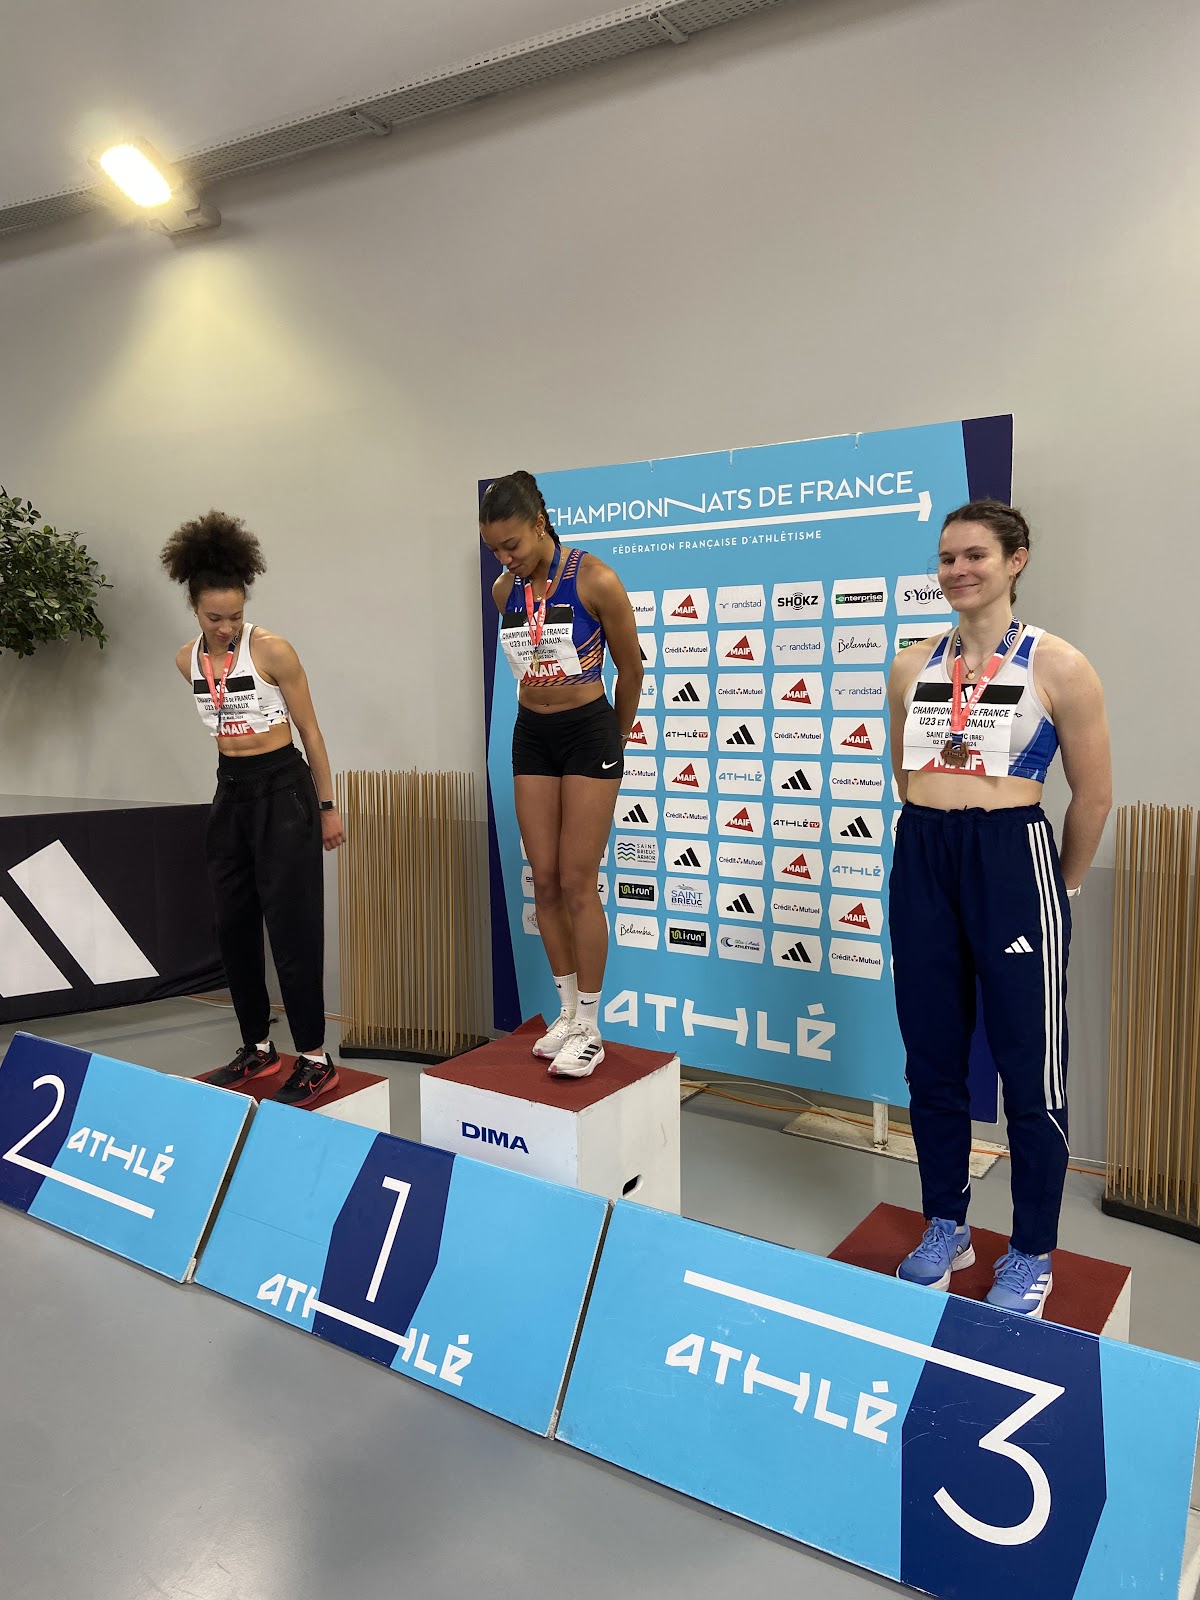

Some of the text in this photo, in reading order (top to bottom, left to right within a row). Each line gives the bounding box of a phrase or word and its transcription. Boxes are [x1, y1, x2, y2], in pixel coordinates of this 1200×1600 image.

[545, 470, 913, 527] CHAMPIONNATS DE FRANCE
[612, 530, 822, 555] FÉDÉRATION FRANÇAISE D'ATHLÉTISME
[777, 594, 819, 608] SHOKZ
[836, 592, 883, 604] enterprise
[732, 600, 762, 609] randstad
[675, 606, 696, 615] MAIF
[547, 628, 569, 636] FRANCE
[528, 637, 562, 646] NONAUX
[789, 642, 821, 651] randstad
[838, 636, 882, 653] Belambra
[730, 648, 752, 656] MAIF
[786, 690, 808, 699] MAIF
[848, 686, 882, 696] randstad
[978, 708, 1010, 718] FRANCE
[920, 717, 936, 726] U23
[946, 718, 996, 728] NONAUX
[220, 724, 250, 735] MAIF
[665, 730, 698, 738] ATHLÉ
[846, 735, 870, 744] MAIF
[718, 771, 762, 782] ATHLÉ
[730, 818, 751, 826] MAIF
[773, 819, 809, 828] ATHLÉ
[786, 864, 808, 873] MAIF
[832, 865, 881, 876] ATHLÉ
[671, 890, 703, 899] SAINT
[671, 897, 702, 906] BRIEUC
[798, 906, 820, 914] Mutuel
[844, 913, 867, 922] MAIF
[620, 924, 654, 936] Belambra
[831, 952, 881, 965] Crédit Mutuel
[604, 990, 836, 1062] ATHLÉ
[462, 1121, 530, 1154] DIMA
[67, 1126, 174, 1184] ATHLÉ
[366, 1176, 412, 1302] 1
[256, 1273, 473, 1386] ATHLÉ
[664, 1333, 897, 1444] ATHLÉ
